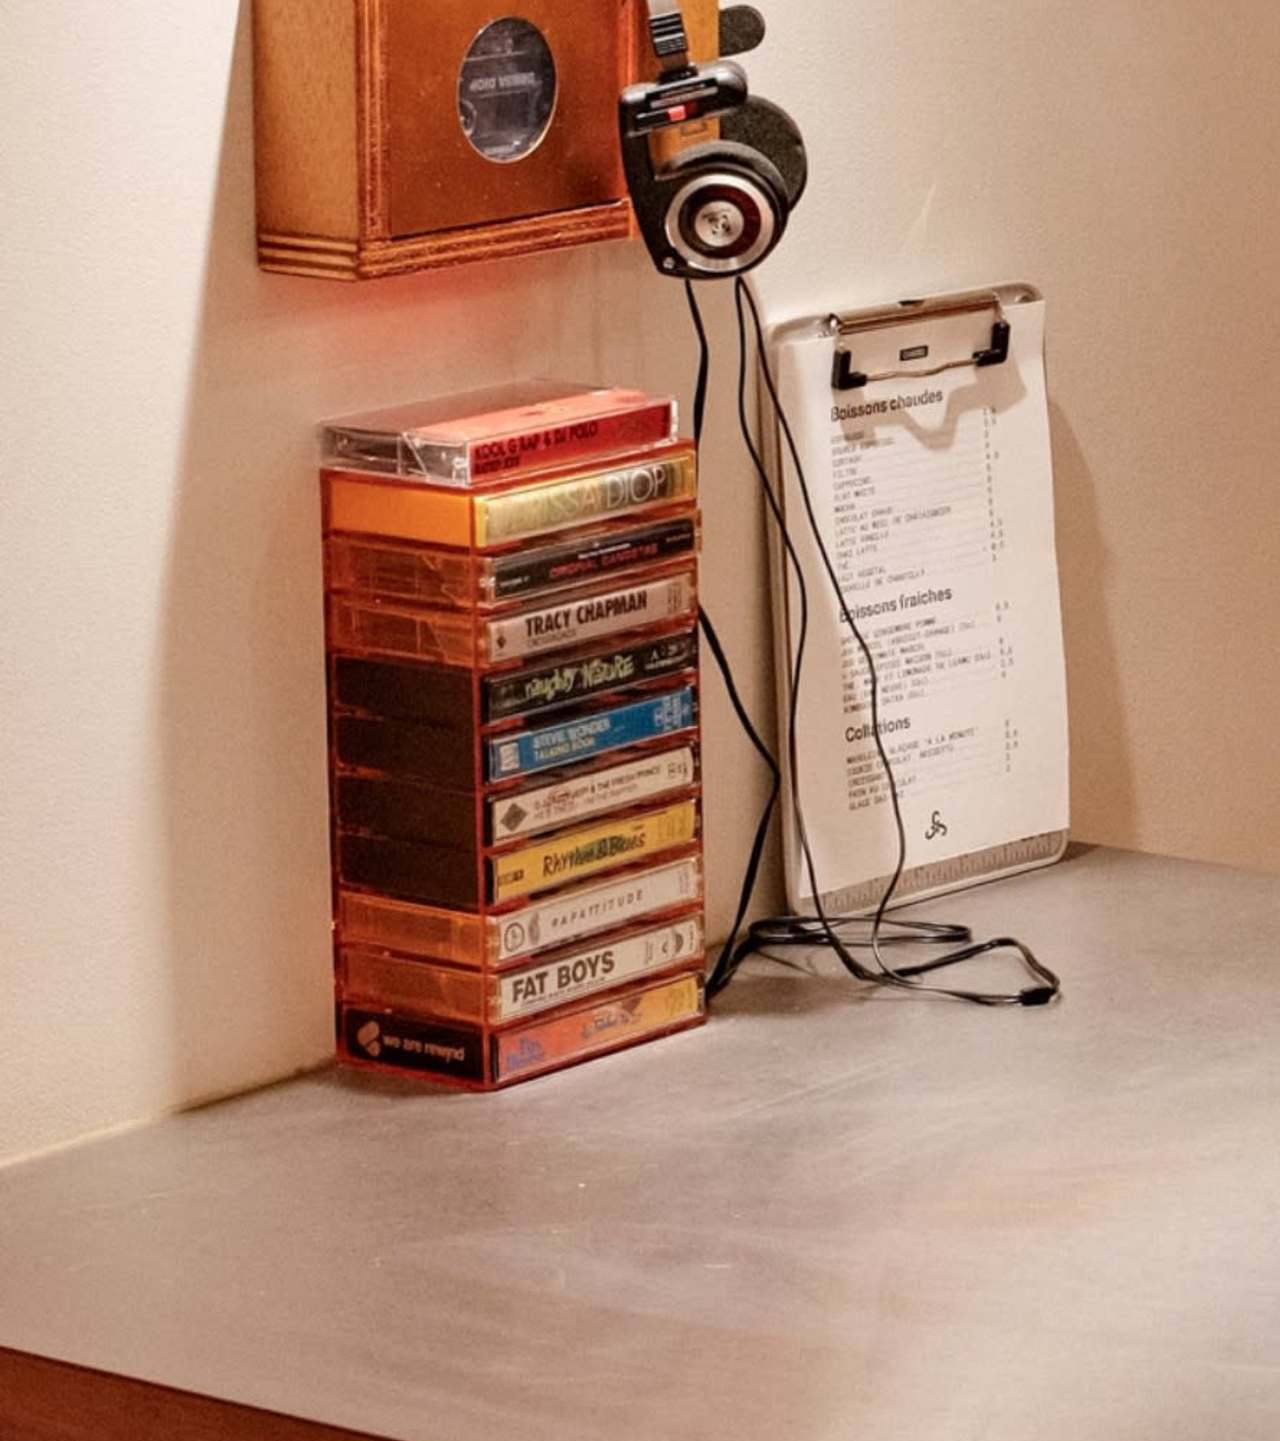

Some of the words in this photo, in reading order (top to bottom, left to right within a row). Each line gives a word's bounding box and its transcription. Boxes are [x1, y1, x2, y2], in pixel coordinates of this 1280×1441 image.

[831, 399, 887, 422] Boissons
[889, 390, 943, 411] chaudes
[607, 463, 666, 508] DIOP
[525, 608, 571, 637] TRACY
[577, 590, 648, 625] CHAPMAN
[845, 717, 911, 742] Colltions
[512, 973, 548, 1003] FAT
[557, 951, 615, 989] BOYS
[383, 1035, 401, 1049] we
